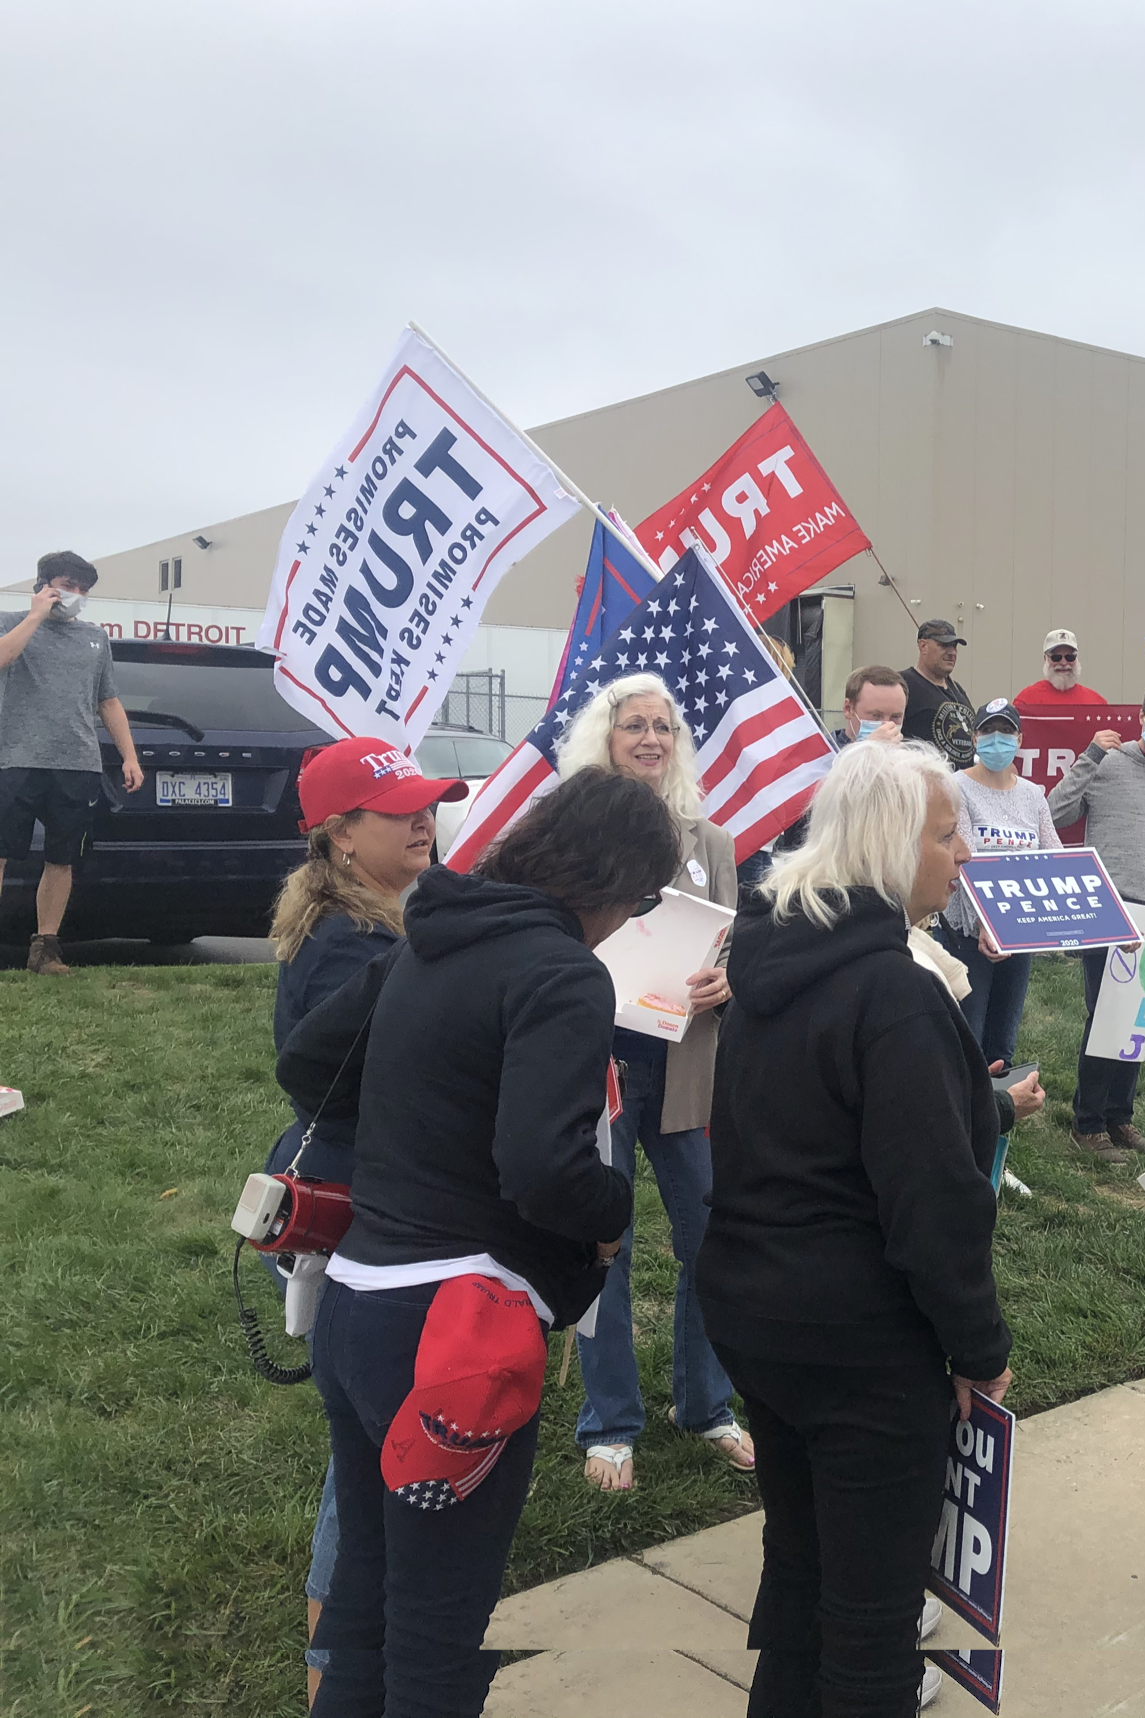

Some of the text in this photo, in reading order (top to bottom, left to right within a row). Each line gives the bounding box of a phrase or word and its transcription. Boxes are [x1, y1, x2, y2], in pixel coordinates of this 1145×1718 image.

[133, 620, 246, 645] DETROIT
[161, 781, 227, 798] DXC 4354
[978, 827, 1036, 841] TRUMP
[983, 837, 1033, 849] PENCE
[973, 875, 1102, 899] TRUMP
[997, 896, 1103, 914] PENCE
[1038, 915, 1071, 923] AMERICA
[1071, 913, 1098, 921] GREAT!
[1060, 939, 1080, 947] 2020
[944, 1456, 981, 1509] NT
